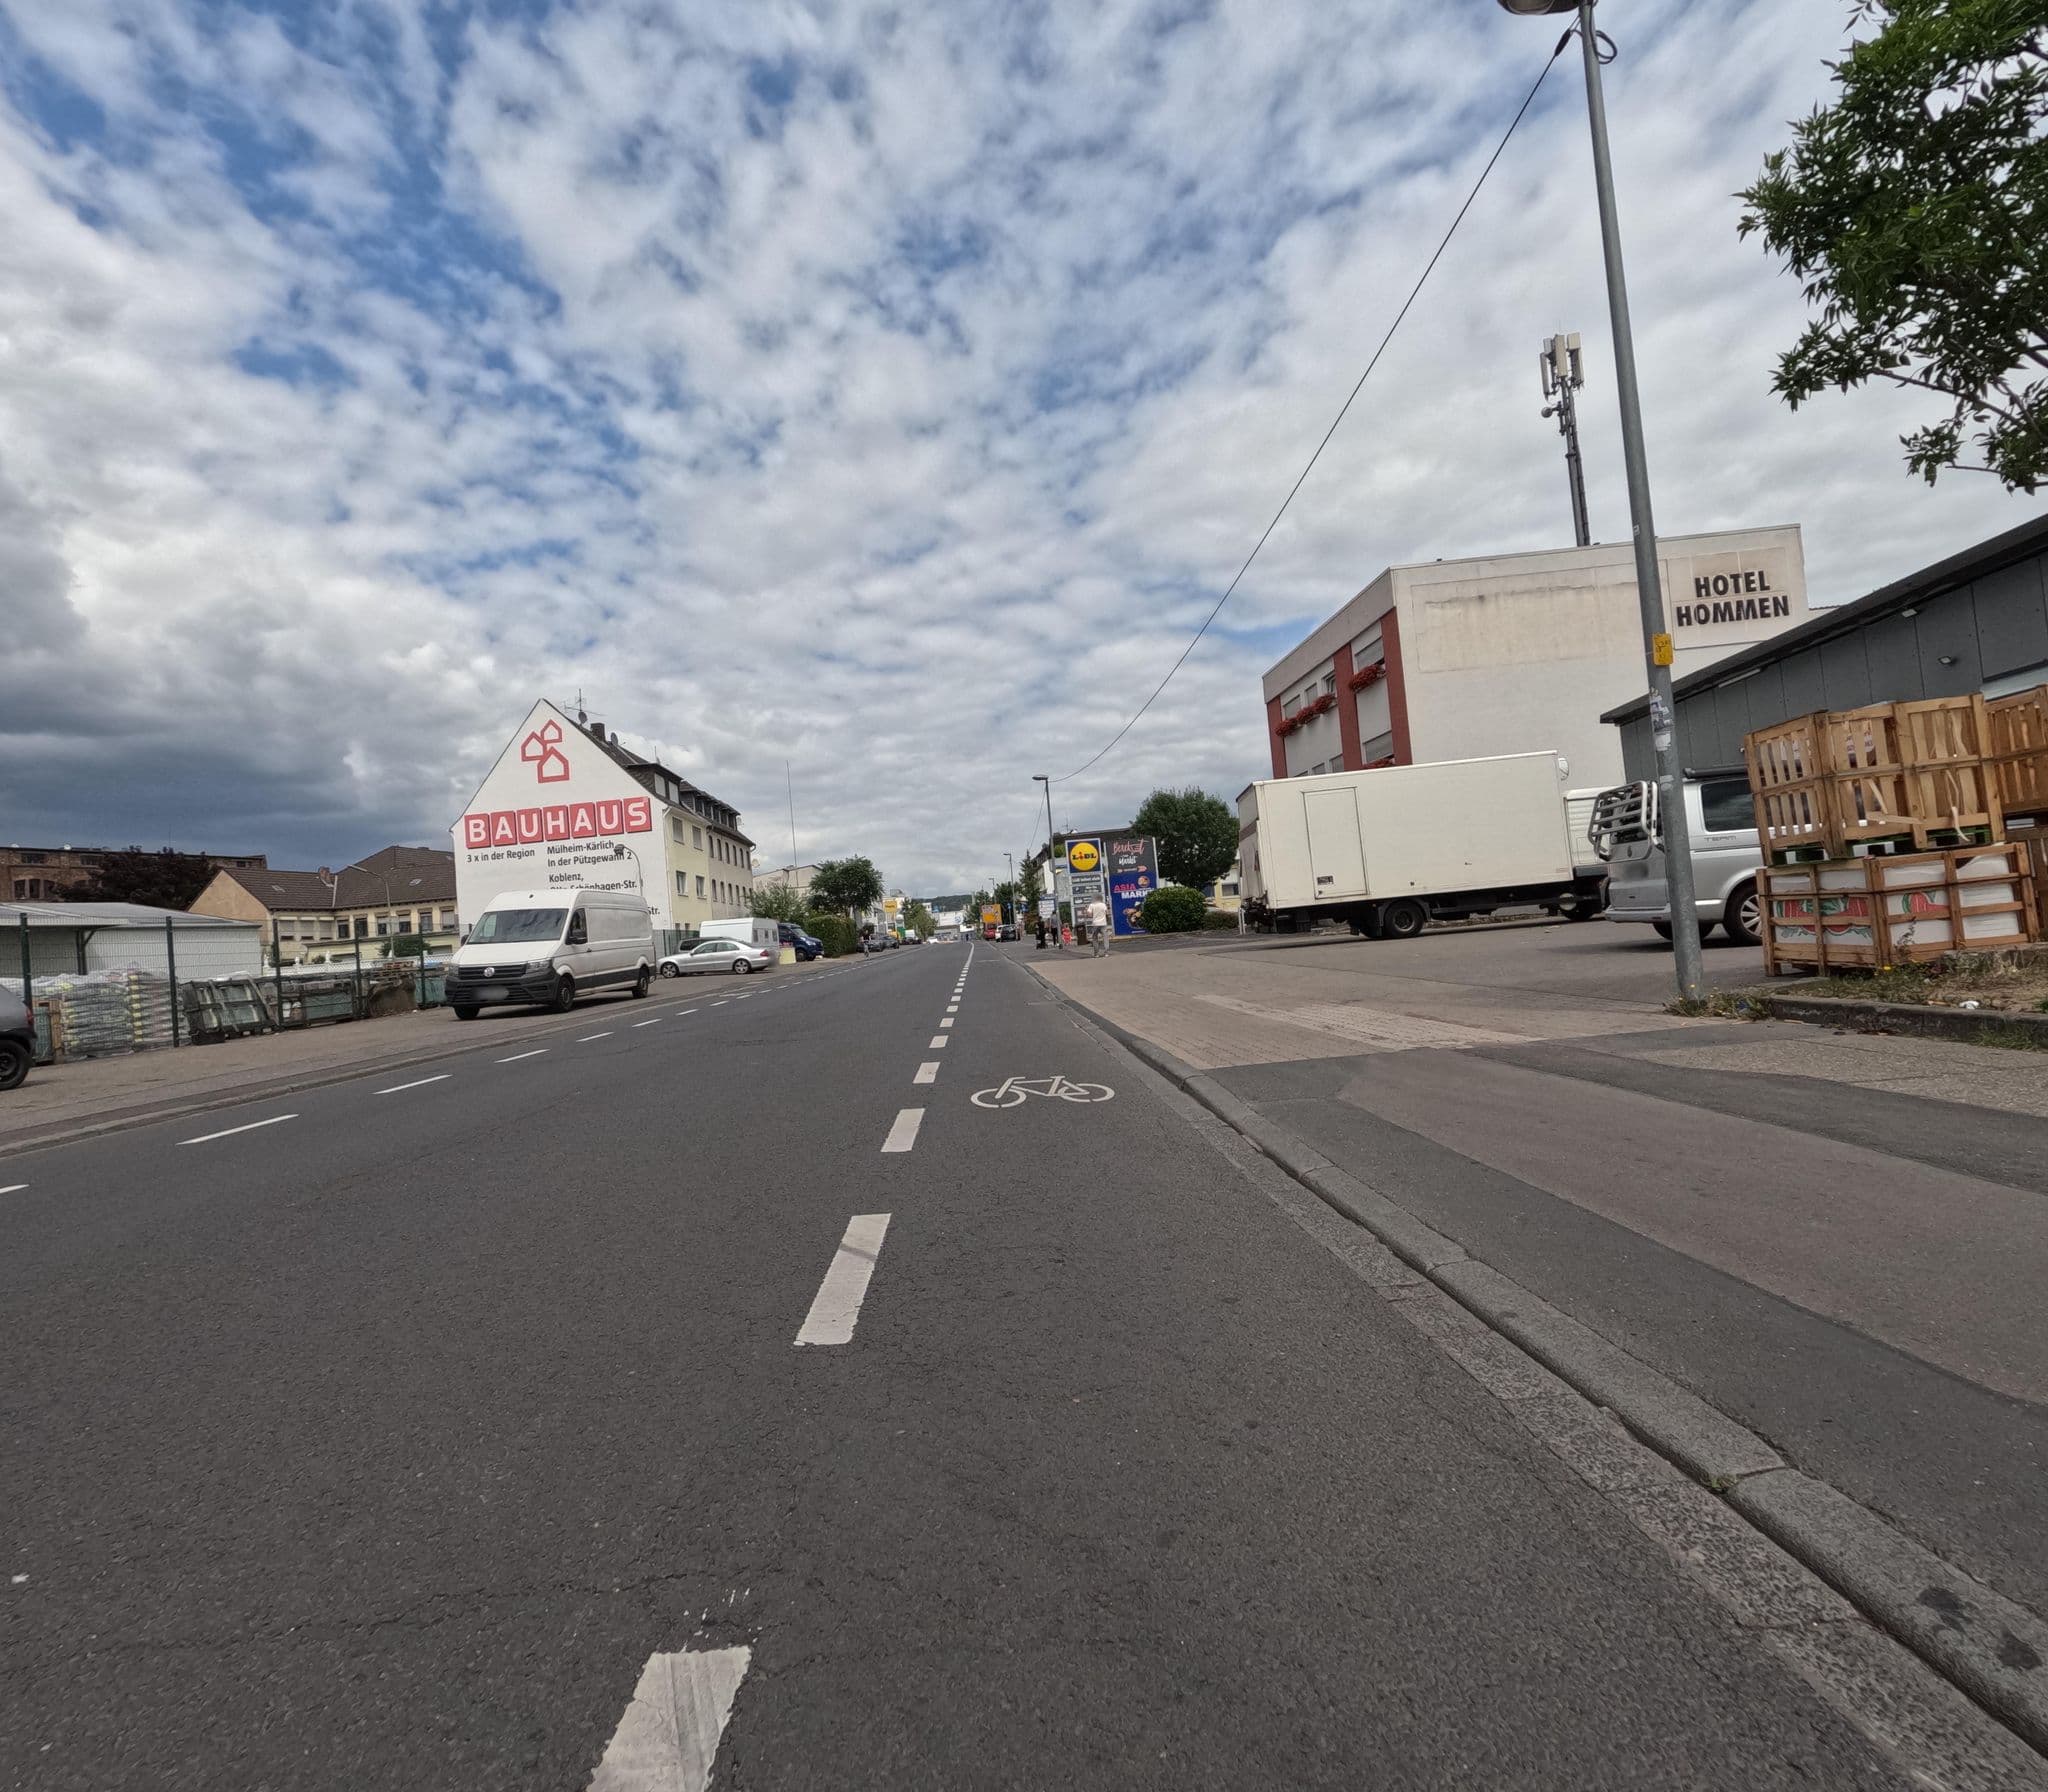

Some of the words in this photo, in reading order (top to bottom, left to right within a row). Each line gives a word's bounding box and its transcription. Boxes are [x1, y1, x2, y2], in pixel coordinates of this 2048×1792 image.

[1695, 570, 1770, 597] HOTEL
[1676, 596, 1789, 626] HOMMEN
[468, 801, 649, 843] BAUHAUS
[547, 840, 614, 854] Mülheim-Kärlich
[466, 854, 472, 863] 3
[481, 852, 489, 862] in
[491, 851, 504, 861] der
[506, 848, 535, 860] Region
[547, 858, 556, 867] In
[557, 857, 571, 866] der
[573, 853, 625, 865] Pützgewann
[626, 851, 633, 860] 2
[549, 873, 584, 883] Koblenz,
[550, 880, 638, 890] hönhagen-Str.
[1113, 883, 1137, 893] ASIA
